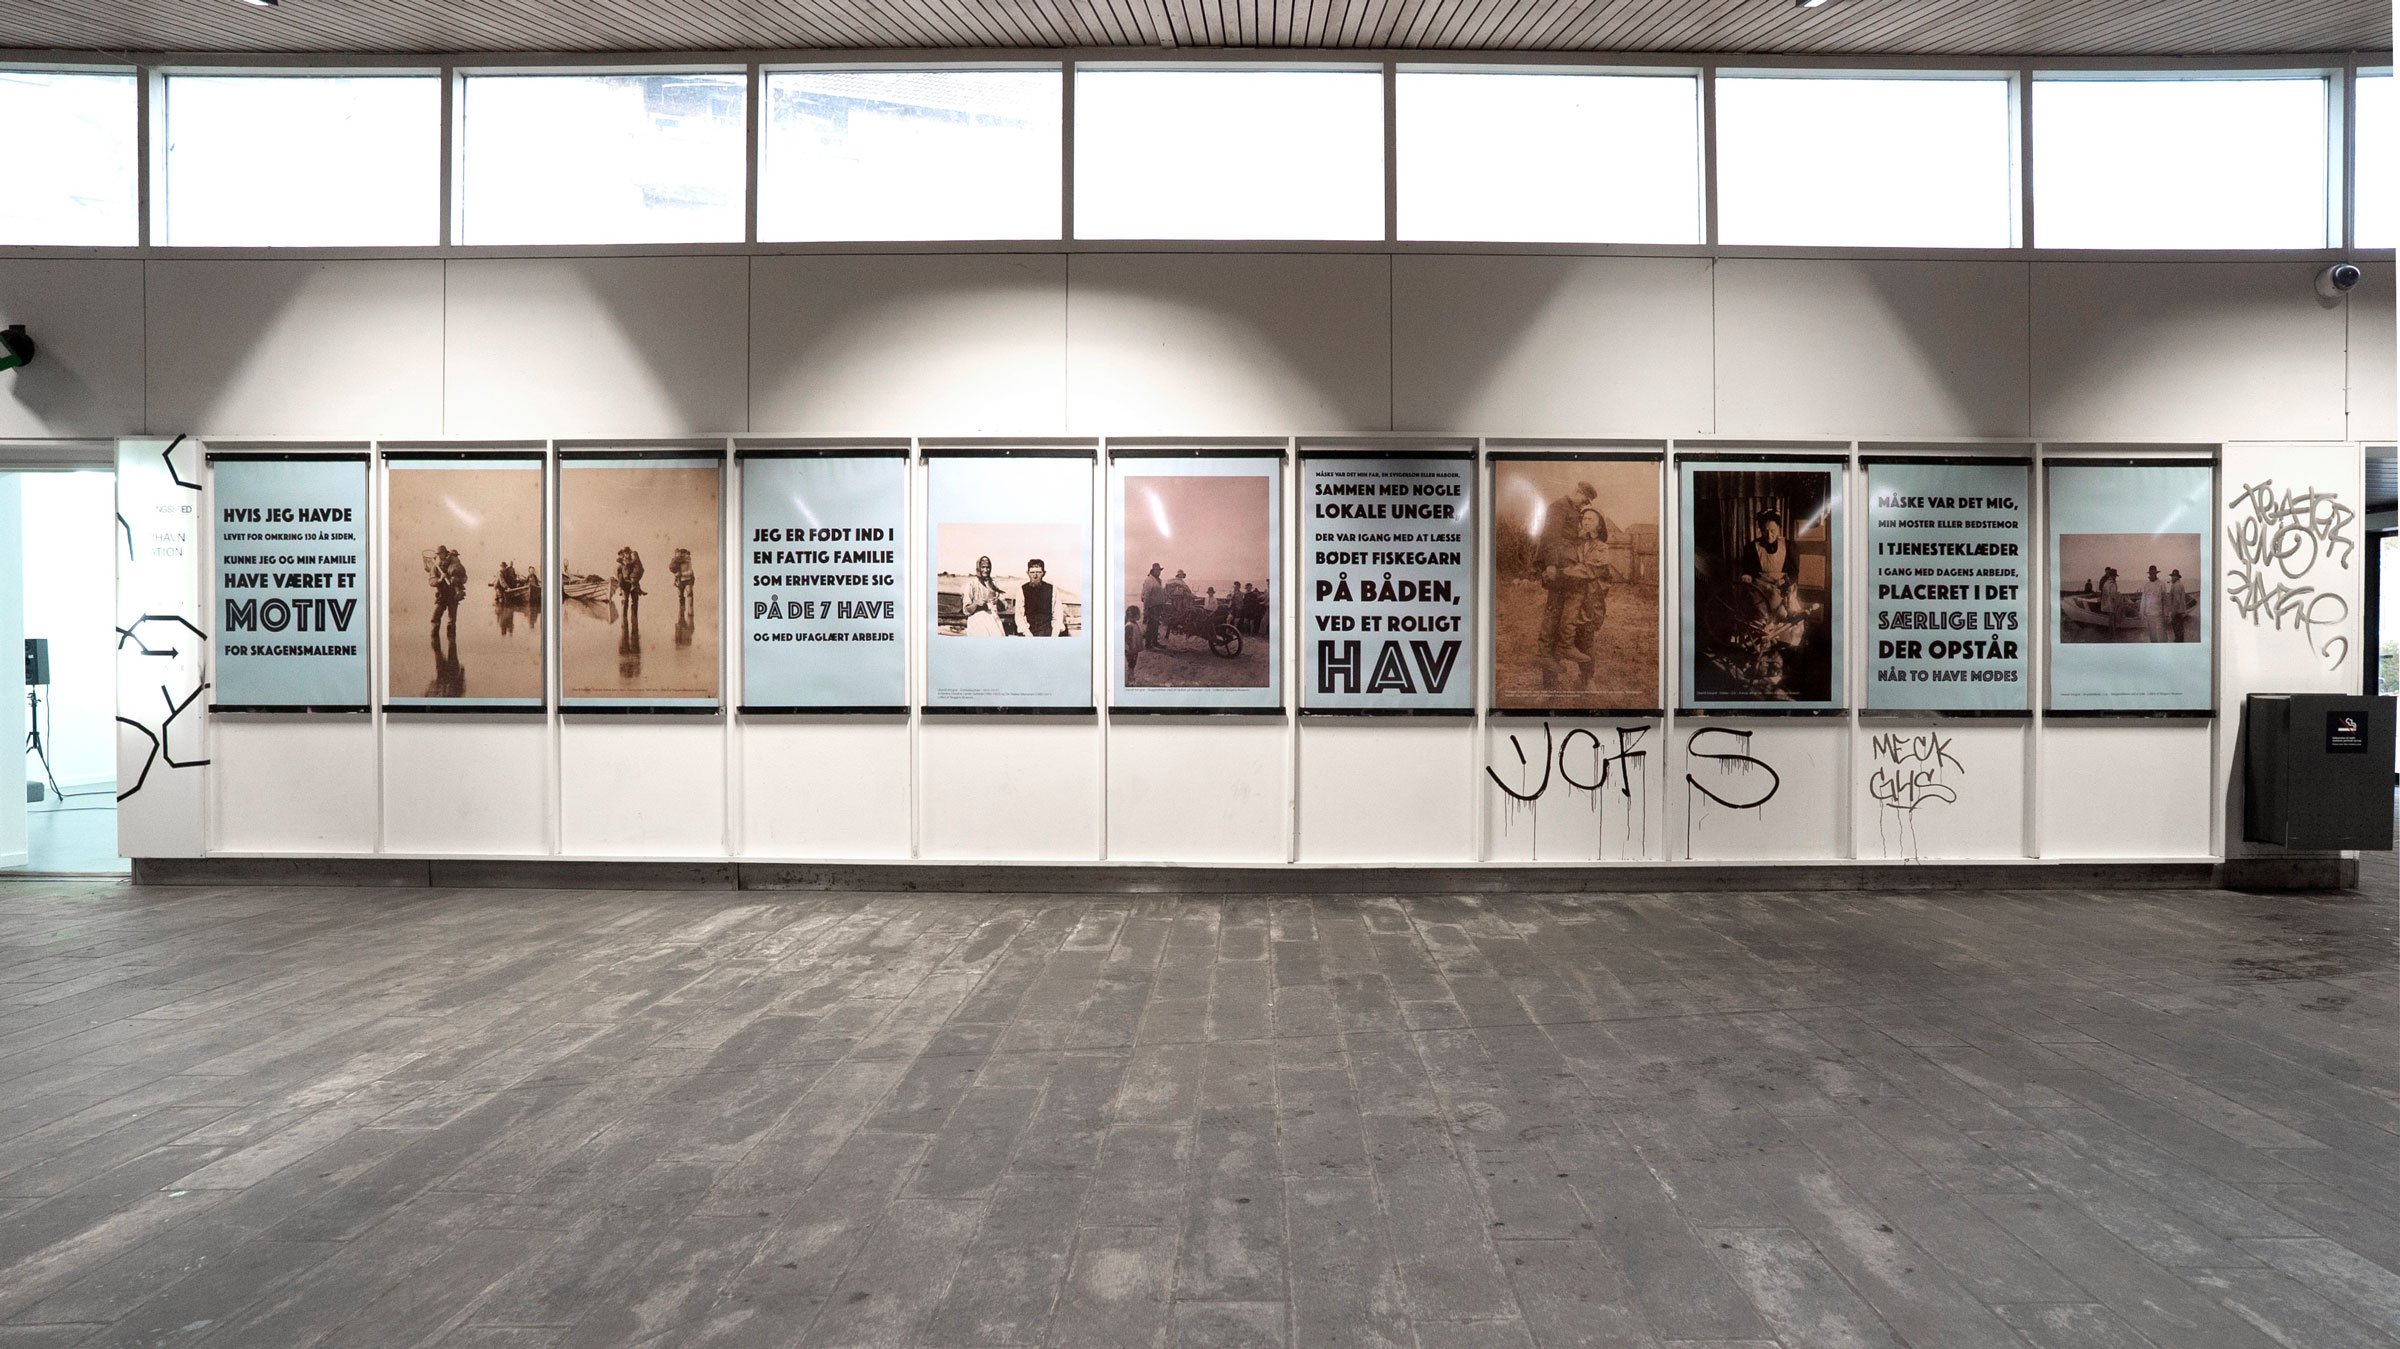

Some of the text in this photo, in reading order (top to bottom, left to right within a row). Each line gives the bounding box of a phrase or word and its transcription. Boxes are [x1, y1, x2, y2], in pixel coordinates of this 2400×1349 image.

[1315, 483, 1461, 496] SAMMEN MED NOGLE
[1878, 492, 2018, 511] MÅSKE VAR DET MIG,
[224, 508, 352, 523] HVIS JEG HAVDE
[1316, 503, 1386, 519] LOKALE
[1878, 520, 2019, 529] MIN MOSTER ELLER BEDSTEMOR
[223, 531, 356, 541] LEVET FOR OMKRING 130 ÅR SIDEN,
[753, 528, 894, 542] JEG ER FØDT IND I
[1315, 533, 1461, 542] DER VAR IGANG MED AT LÆSSE
[1879, 542, 2019, 556] I TJENESTEKLÆDER
[224, 555, 356, 565] KUNNE JEG OG MIN FAMILIE
[753, 550, 894, 564] EN FATTIG FAMILIE
[1316, 551, 1461, 565] BØDET FISKEGARN
[753, 574, 894, 586] SOM ERHVERVEDE SIG
[1878, 568, 2019, 578] I GANG MED DAGENS ARBEJDE,
[224, 573, 356, 588] HAVE VÆRET ET
[1316, 571, 1461, 606] PÅ BÅDEN,
[1879, 584, 2019, 600] PLACERET I DET
[754, 594, 894, 619] PÅ DE 7 HAVE
[225, 598, 358, 632] MOTIV
[1878, 611, 2018, 630] SÆRLIGE LYS
[1315, 615, 1461, 632] VED ET ROLIGT
[753, 632, 894, 642] OG MED UFAGLÆRT ARBEJDE
[225, 645, 357, 656] FOR SKAGENSMALERNE
[1879, 633, 2018, 660] DER OPSTÅR
[1318, 640, 1462, 694] HAV
[1878, 666, 2018, 682] NÅR TO HAVE MØDES
